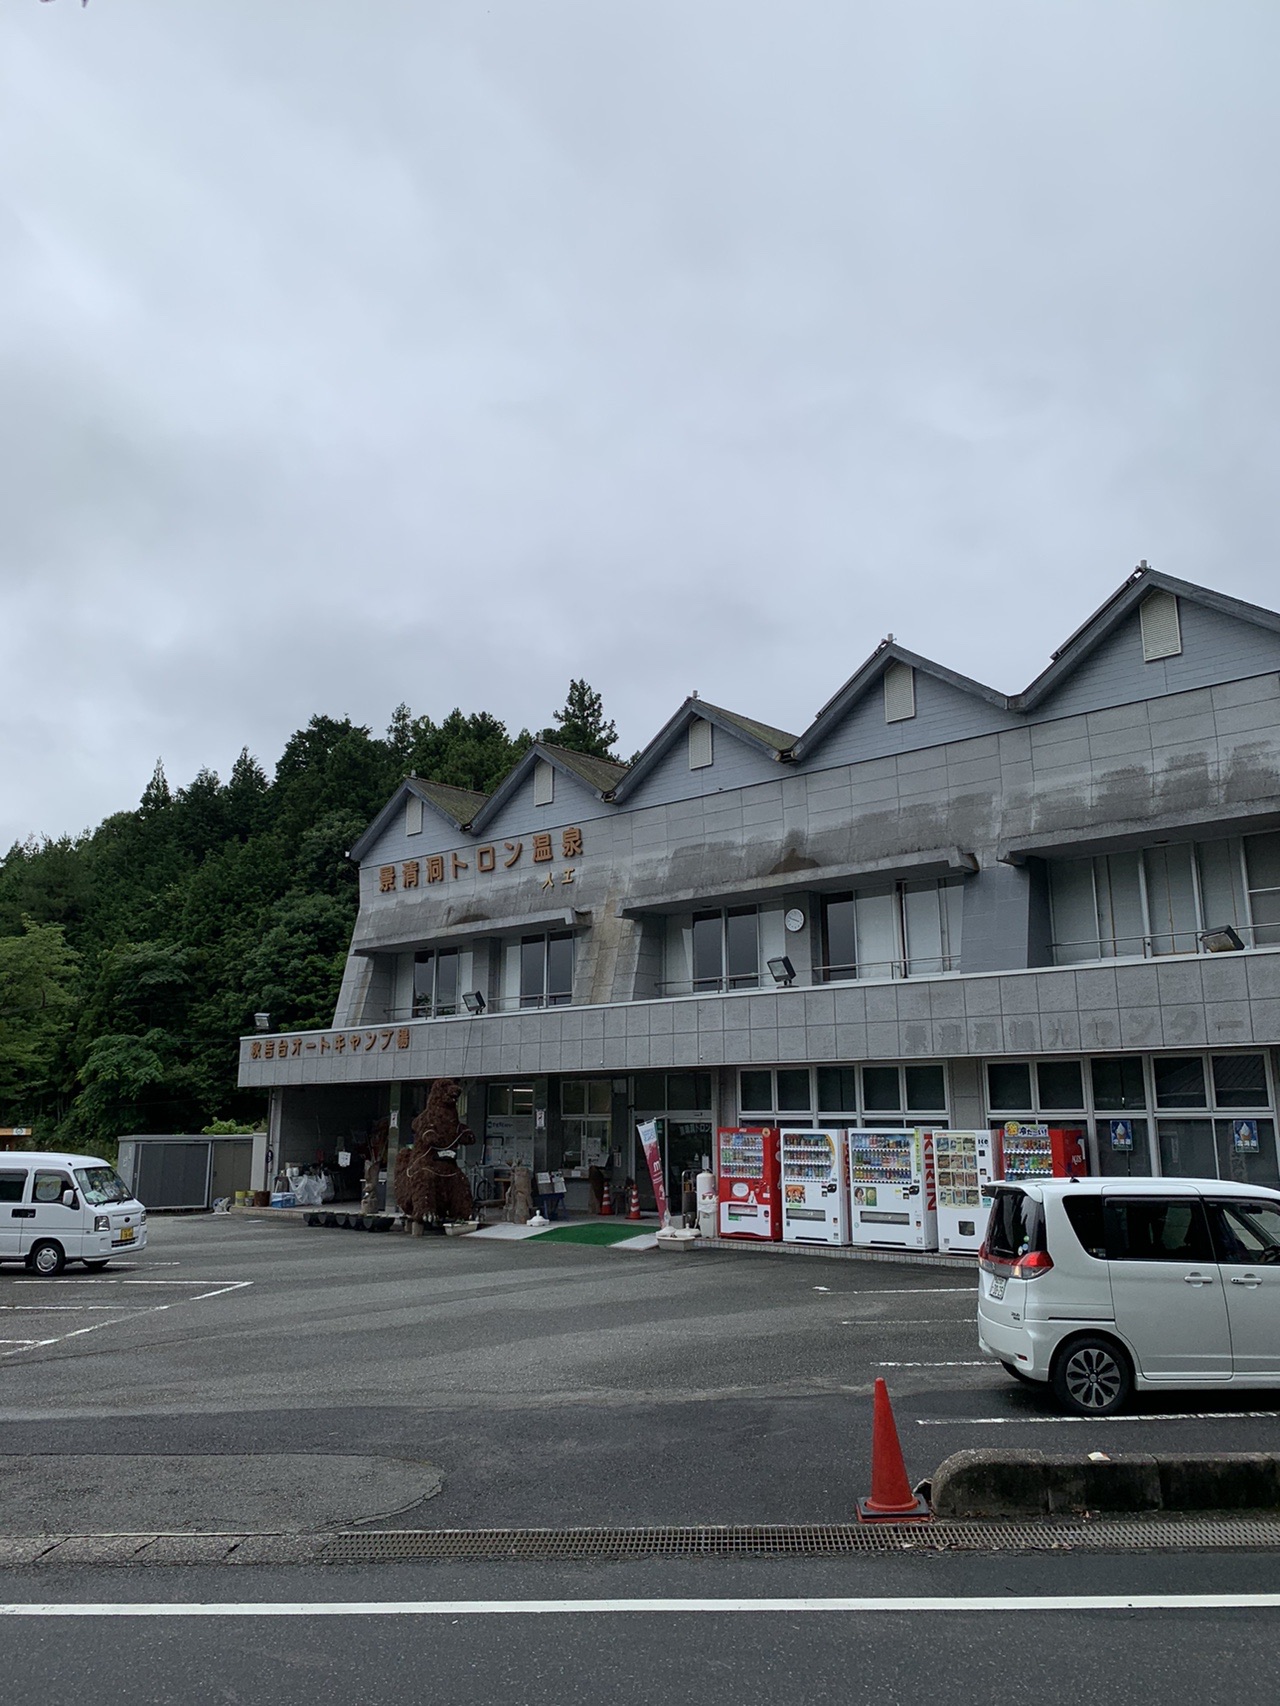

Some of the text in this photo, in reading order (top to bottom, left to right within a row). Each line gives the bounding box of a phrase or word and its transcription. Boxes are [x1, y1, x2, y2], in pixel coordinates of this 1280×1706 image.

[378, 827, 583, 892] 景清洞トロン温泉
[542, 867, 576, 889] 人工
[251, 1028, 410, 1059] 秋吉台オートキャンプ場
[923, 1134, 937, 1210] KIRIN
